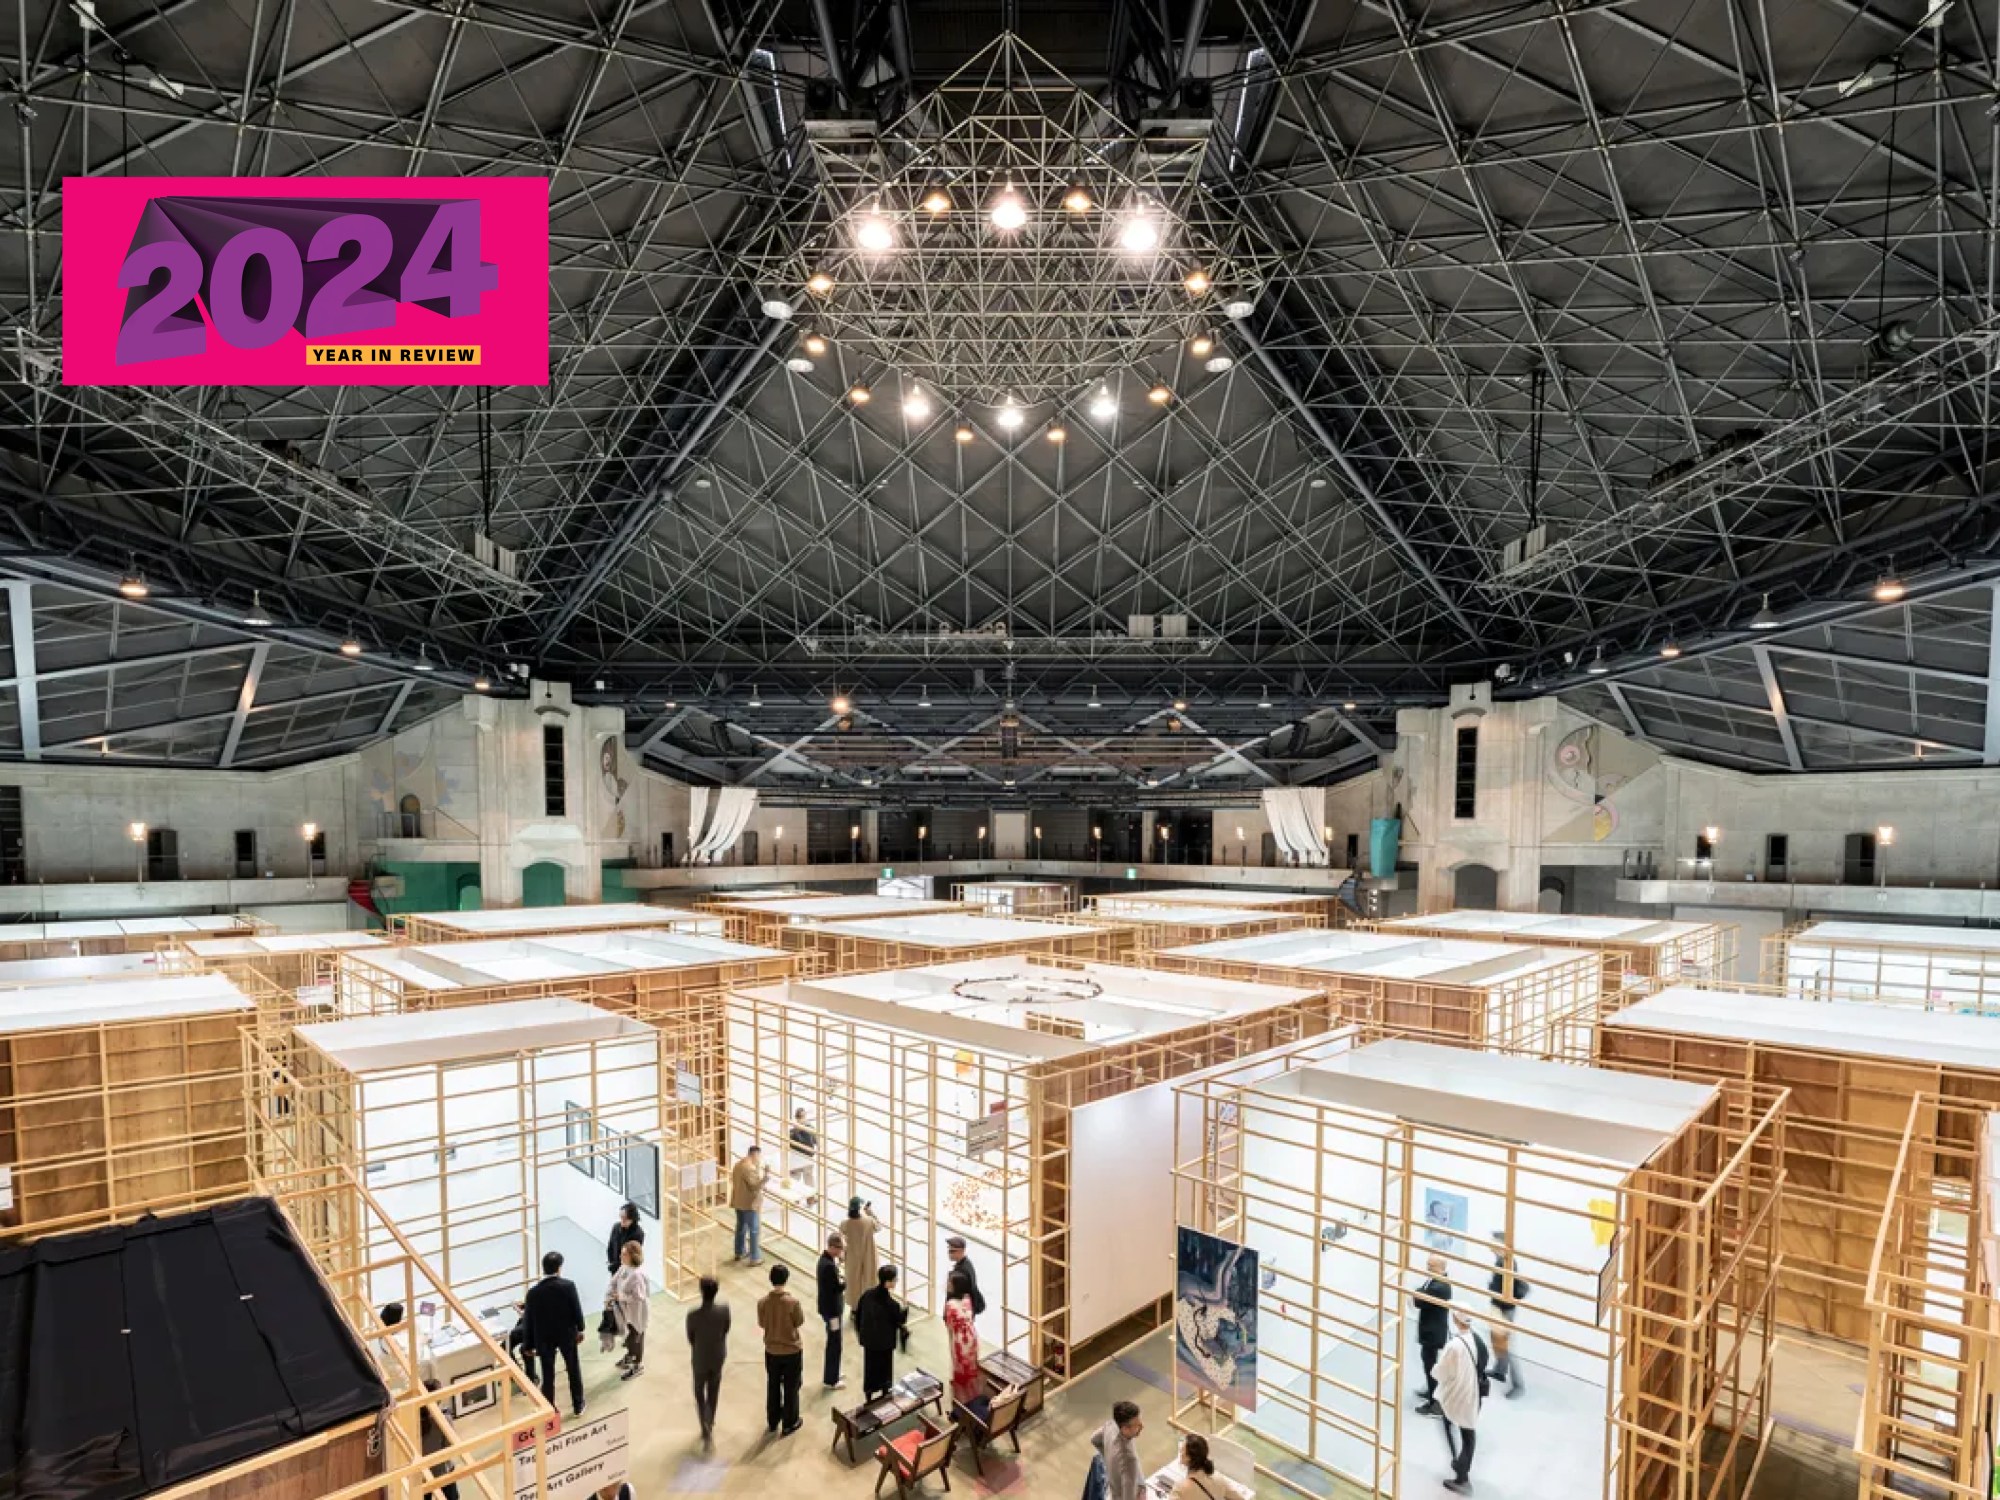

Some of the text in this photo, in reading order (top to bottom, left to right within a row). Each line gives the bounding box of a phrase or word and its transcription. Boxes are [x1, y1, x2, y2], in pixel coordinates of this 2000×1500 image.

[565, 1433, 588, 1447] Fine
[591, 1424, 608, 1436] Art
[565, 1462, 605, 1483] Gallery
